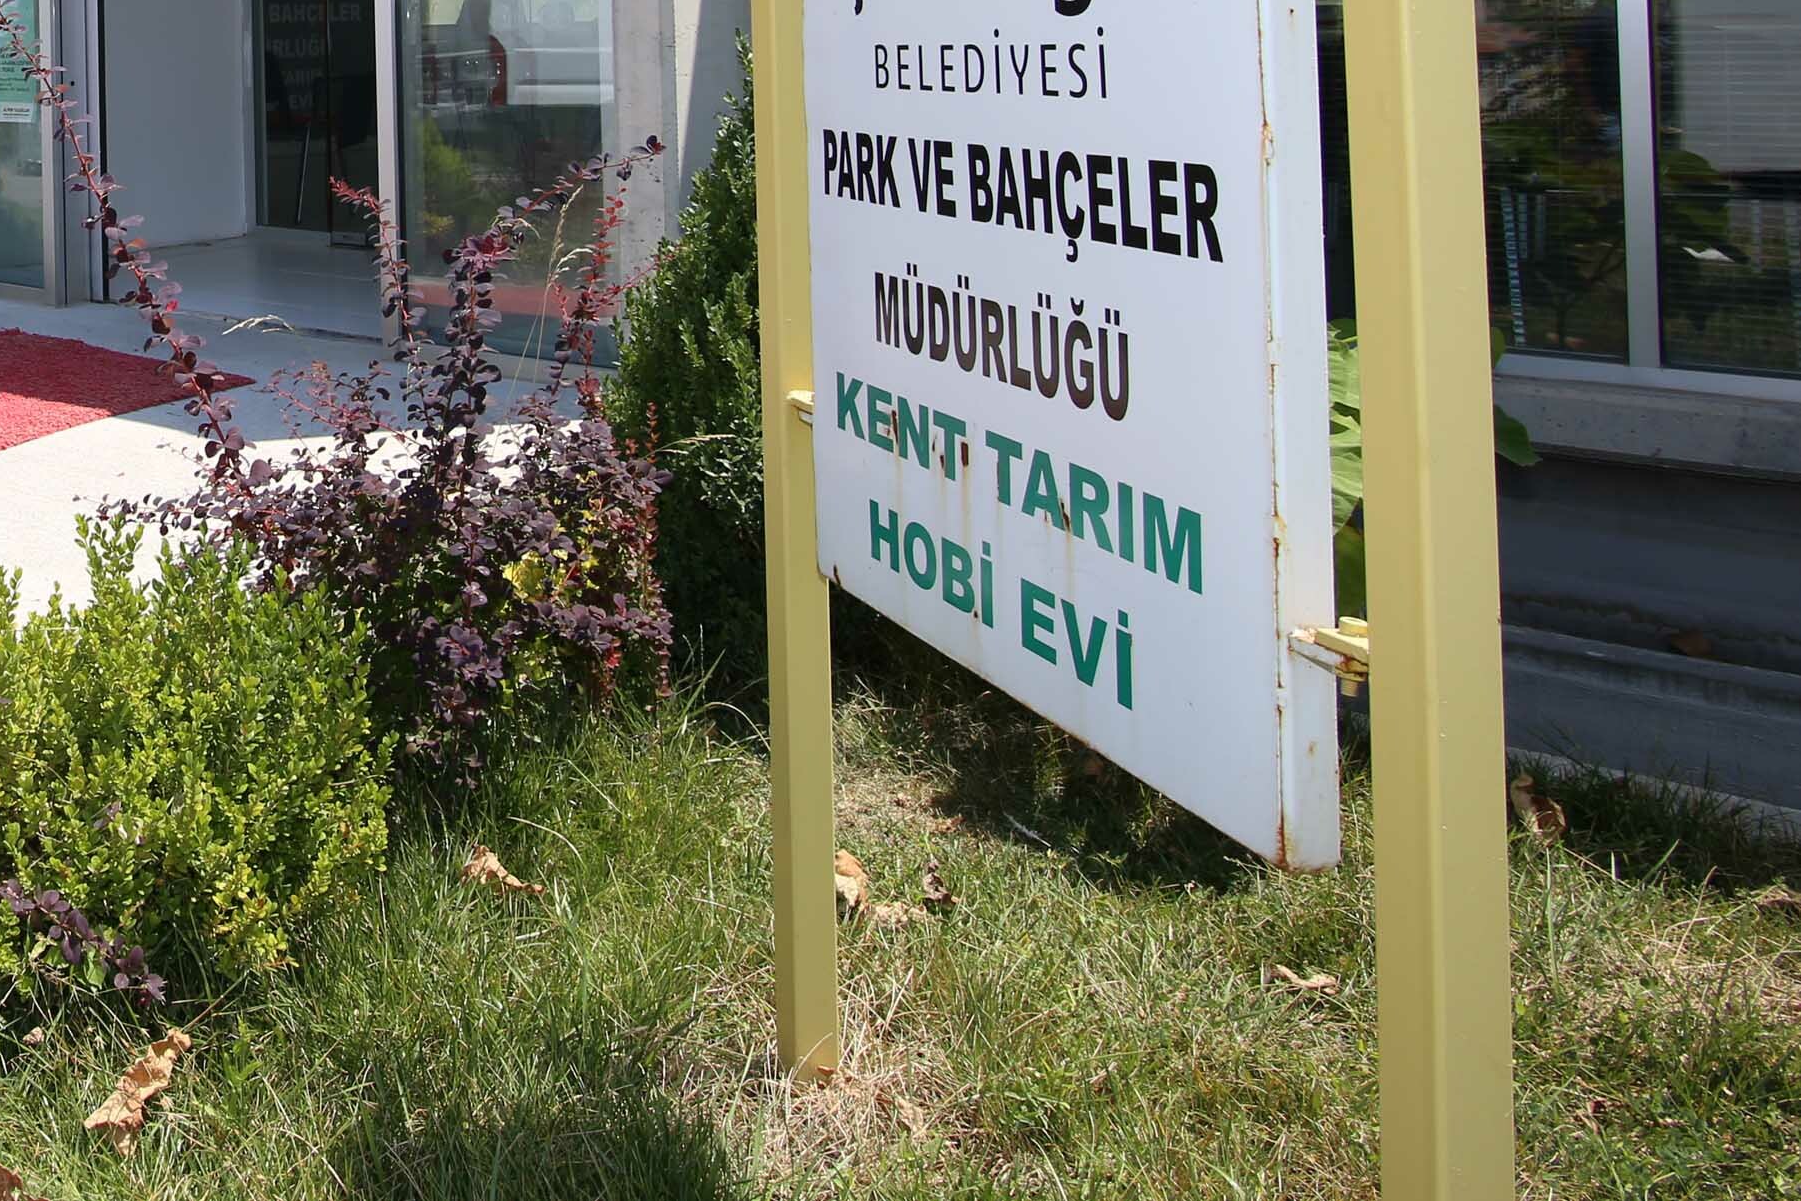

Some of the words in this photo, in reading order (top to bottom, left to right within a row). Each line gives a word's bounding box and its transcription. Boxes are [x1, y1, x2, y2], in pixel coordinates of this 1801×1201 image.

[874, 26, 1107, 99] BELEDİYESİ
[822, 128, 901, 209] PARK
[907, 137, 957, 219] VE
[966, 143, 1224, 264] BAHÇELER
[874, 264, 1130, 422] MÜDÜRLÜĞÜ
[837, 373, 967, 480] KENT
[986, 430, 1203, 595] TARIM
[869, 499, 994, 629] HOBİ
[1021, 578, 1133, 710] EVİ
